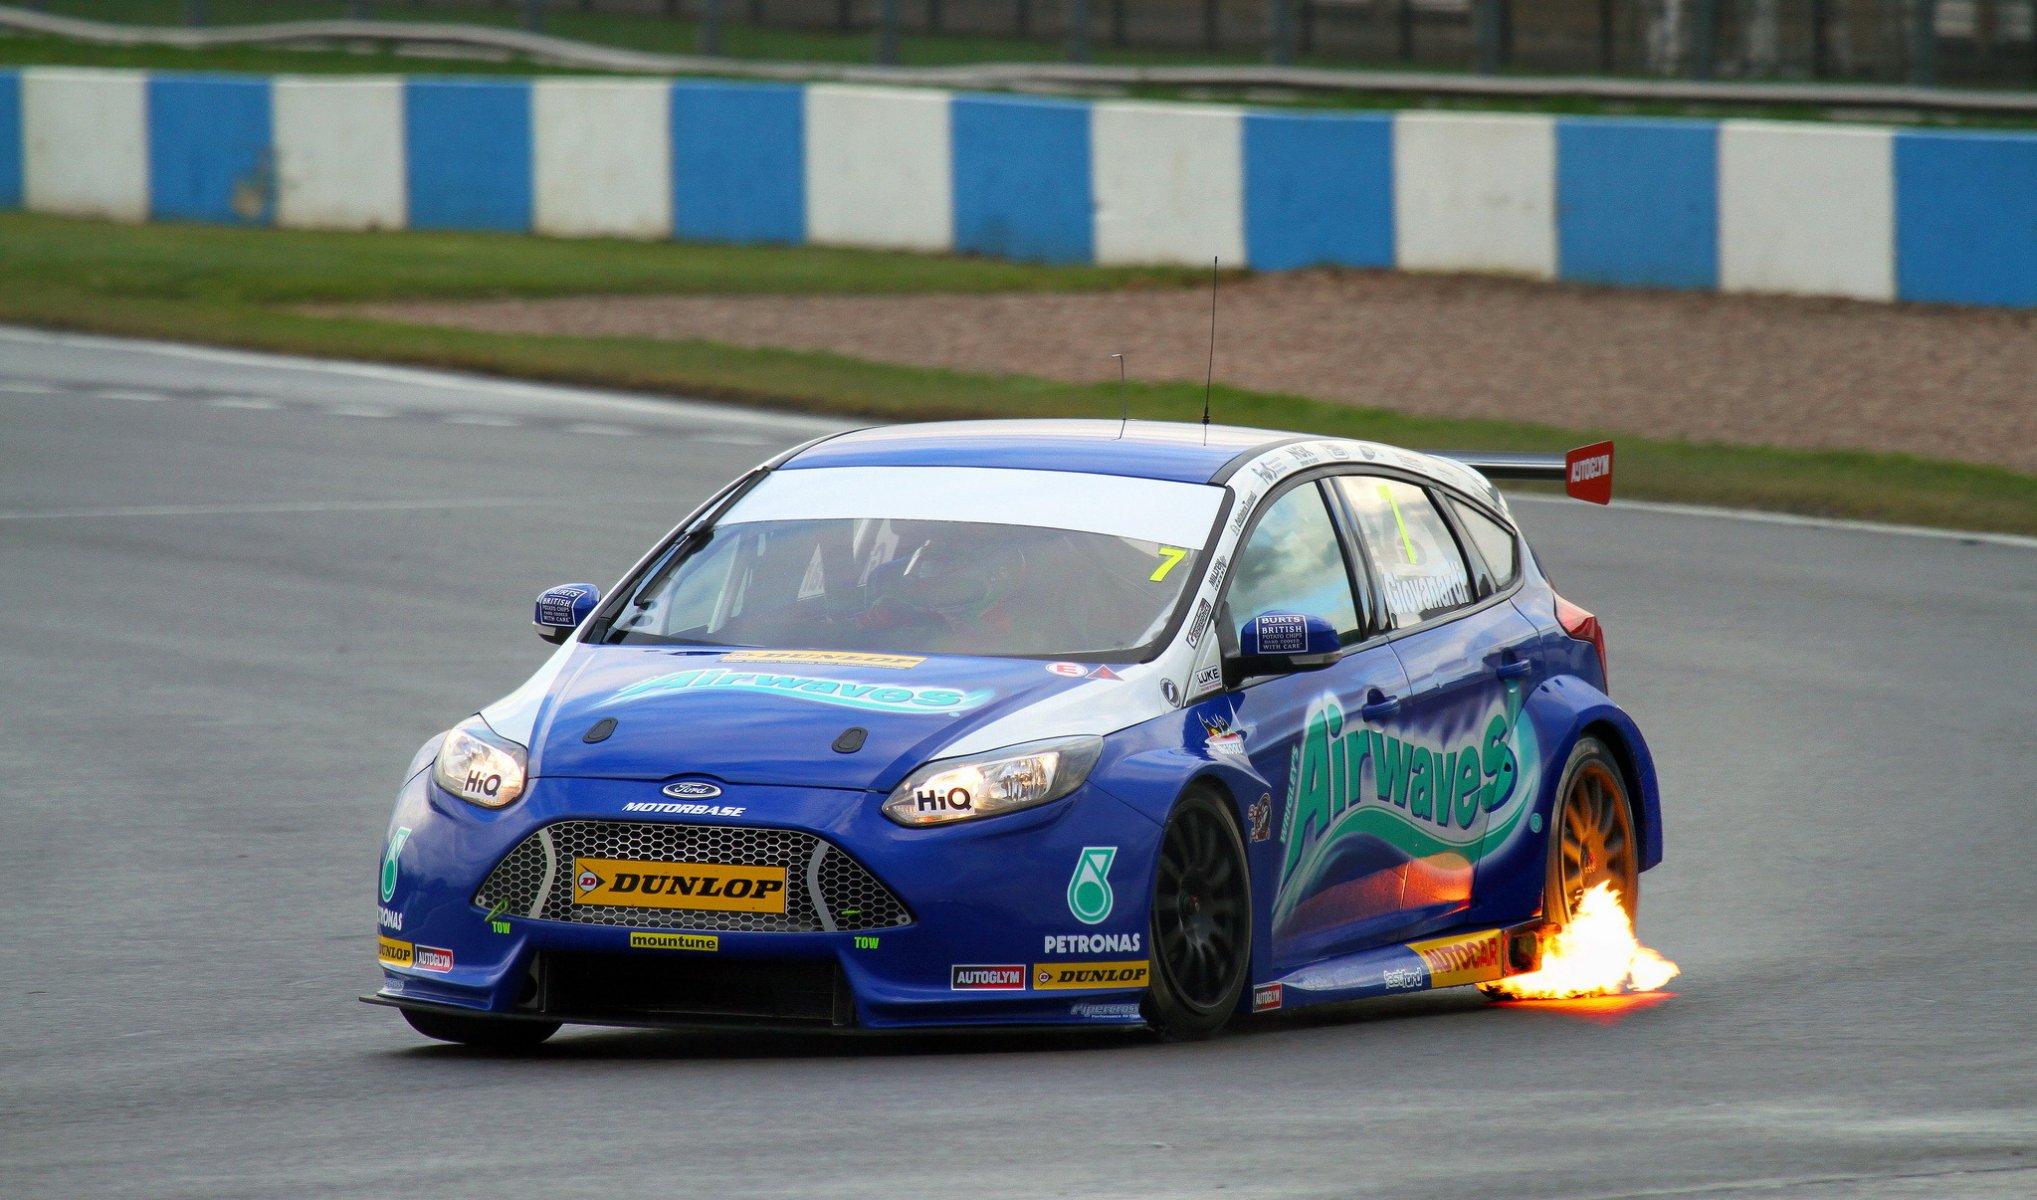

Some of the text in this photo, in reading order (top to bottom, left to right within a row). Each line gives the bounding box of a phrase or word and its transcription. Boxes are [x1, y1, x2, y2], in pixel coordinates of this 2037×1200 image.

[1571, 454, 1610, 483] AUTOGLYM
[1150, 548, 1189, 582] 7
[542, 598, 571, 607] BRITISH
[1261, 616, 1301, 624] BURTS
[1262, 626, 1302, 634] BRITISH
[1197, 668, 1220, 684] LUKE
[645, 669, 965, 709] Airwaves
[464, 770, 502, 798] HiQ
[674, 783, 710, 797] Ford
[916, 787, 973, 813] HiQ
[1282, 703, 1518, 895] Airwaves
[622, 802, 747, 818] MOTORBASE
[608, 873, 784, 899] DUNLOP
[492, 921, 511, 934] TOW
[632, 935, 717, 949] mountune
[854, 936, 880, 950] TOW
[1044, 933, 1141, 954] PETRONAS
[418, 951, 451, 968] AUTOGLYM
[1423, 937, 1498, 973] AUTOCAR
[956, 971, 1020, 984] AUTOGLYM
[1057, 968, 1147, 983] DUNLOP
[1255, 987, 1281, 1006] AUTOGLYM
